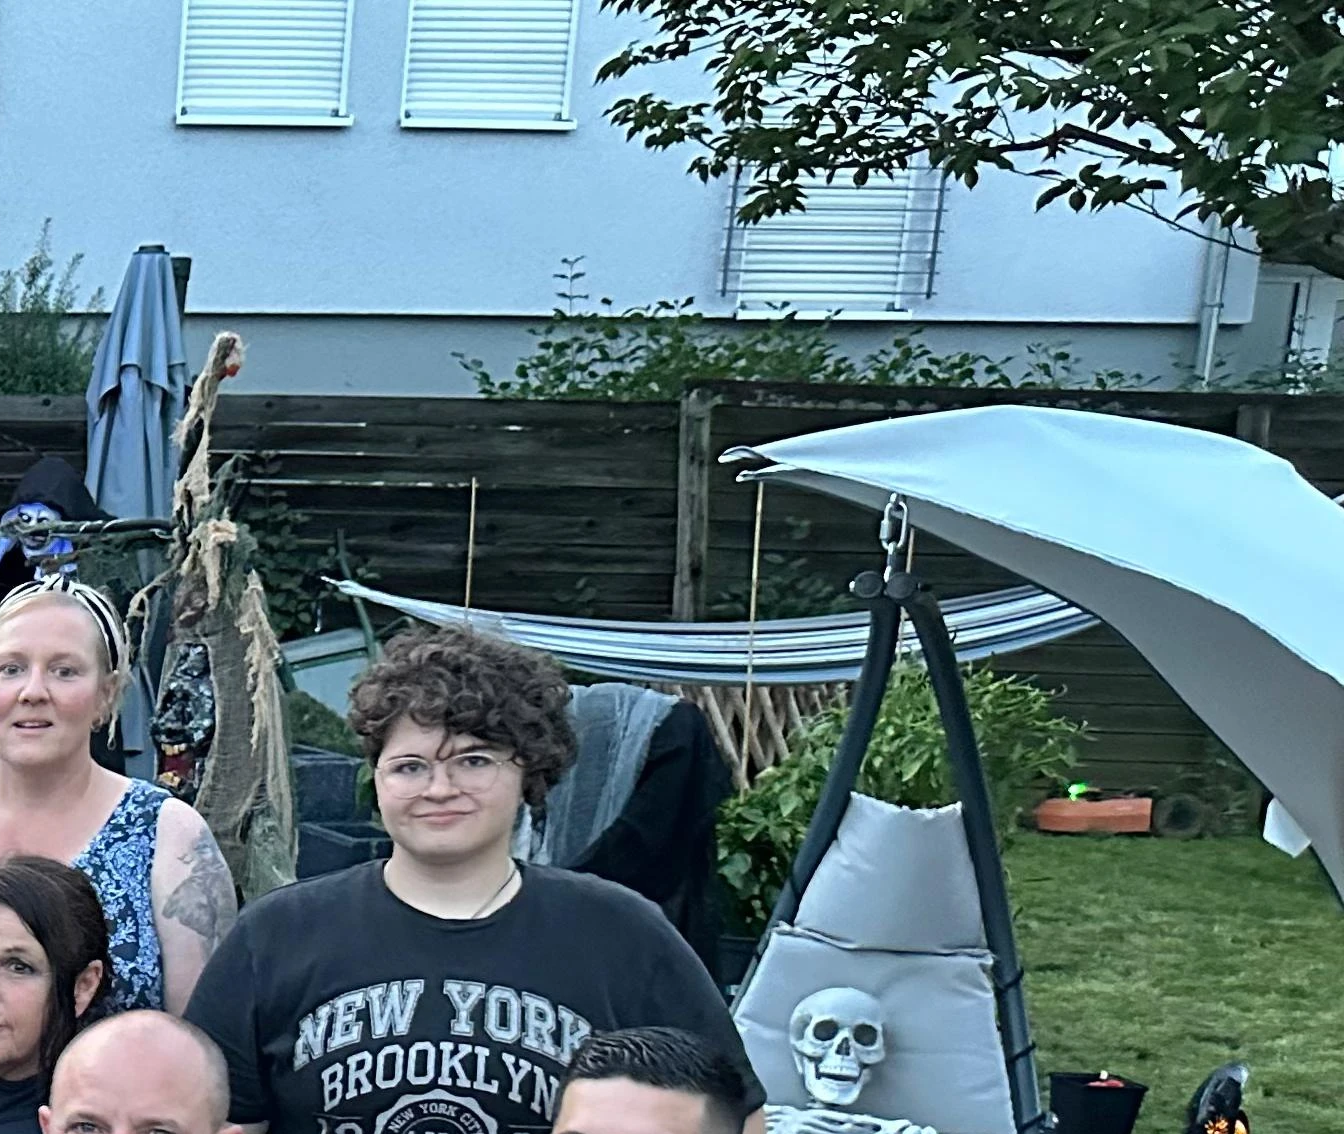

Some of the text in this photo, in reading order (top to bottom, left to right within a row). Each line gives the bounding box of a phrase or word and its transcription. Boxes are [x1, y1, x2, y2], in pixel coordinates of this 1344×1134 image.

[293, 978, 592, 1072] NEW YORK
[321, 1041, 561, 1122] BROOKLYN
[387, 1107, 415, 1134] NEW
[419, 1102, 459, 1118] YORK
